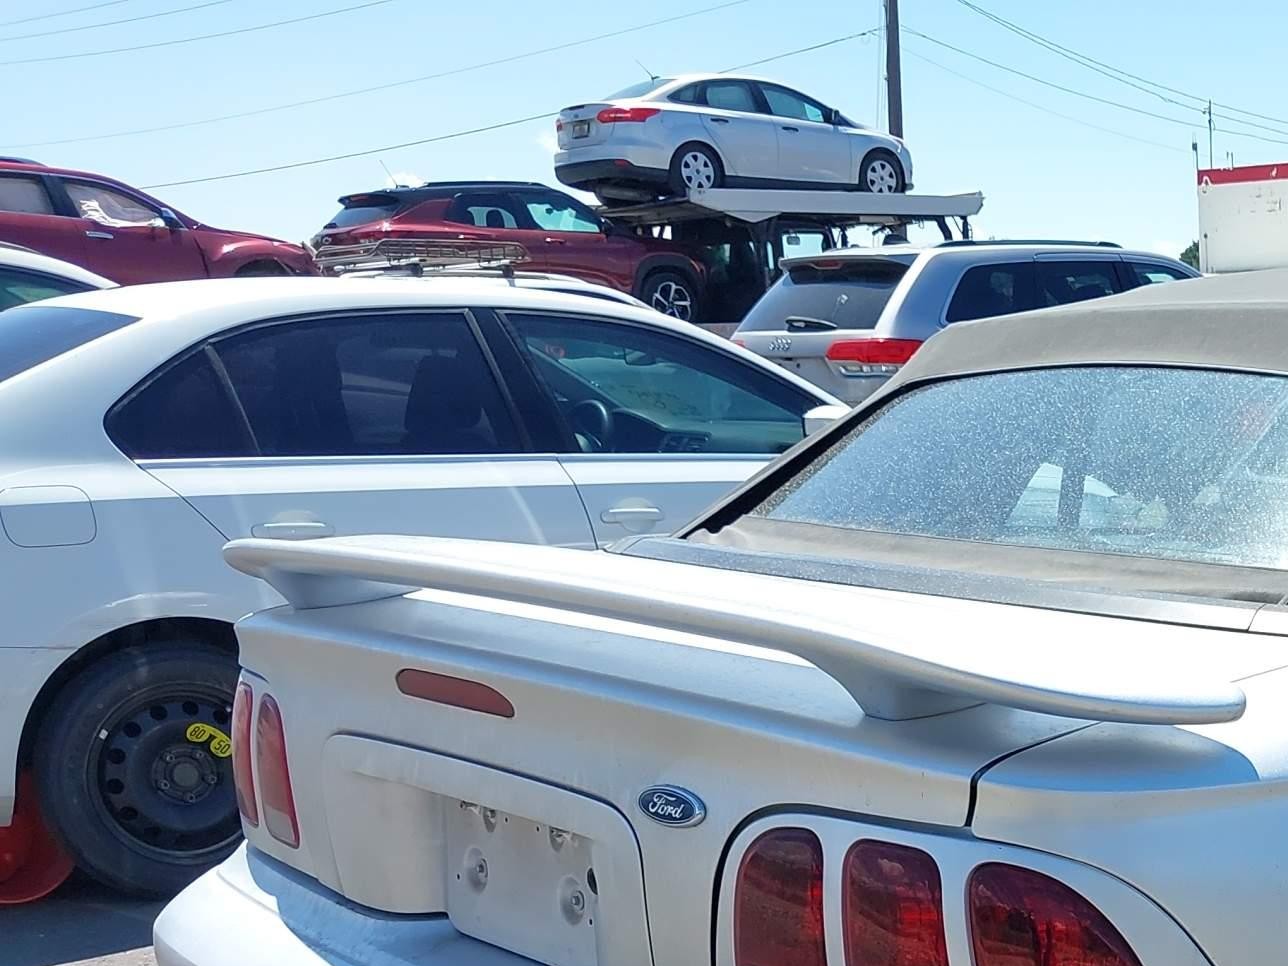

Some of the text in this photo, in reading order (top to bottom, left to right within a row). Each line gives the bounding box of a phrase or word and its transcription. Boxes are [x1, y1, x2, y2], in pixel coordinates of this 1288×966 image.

[190, 726, 206, 739] 80
[214, 740, 230, 754] 50
[648, 792, 685, 819] Ford
